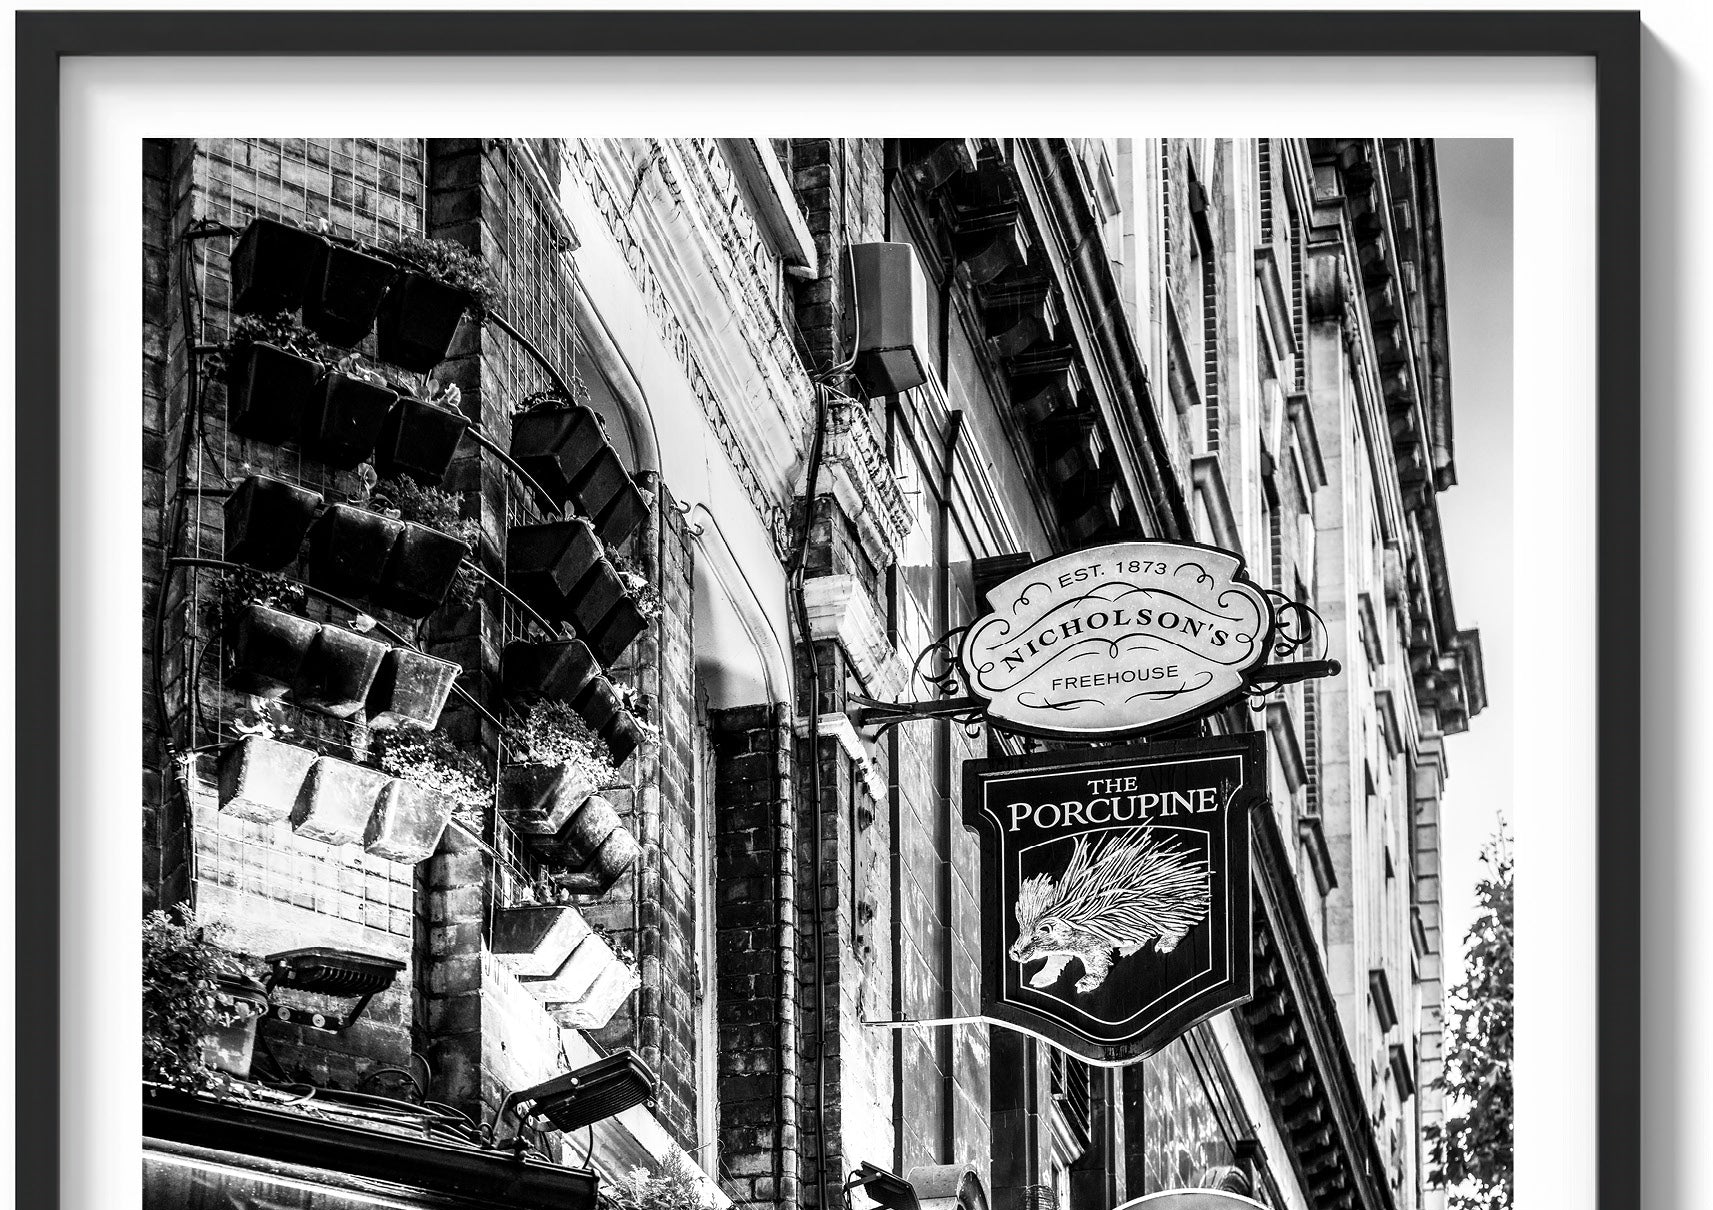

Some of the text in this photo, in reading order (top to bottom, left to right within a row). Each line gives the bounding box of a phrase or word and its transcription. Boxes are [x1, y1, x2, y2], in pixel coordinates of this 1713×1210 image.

[1058, 560, 1168, 588] EST. 1873
[1000, 608, 1229, 673] NICHOLSON'S
[1051, 665, 1179, 691] FREEHOUSE
[1087, 776, 1139, 796] THE
[1006, 787, 1219, 832] PORCUPINE
